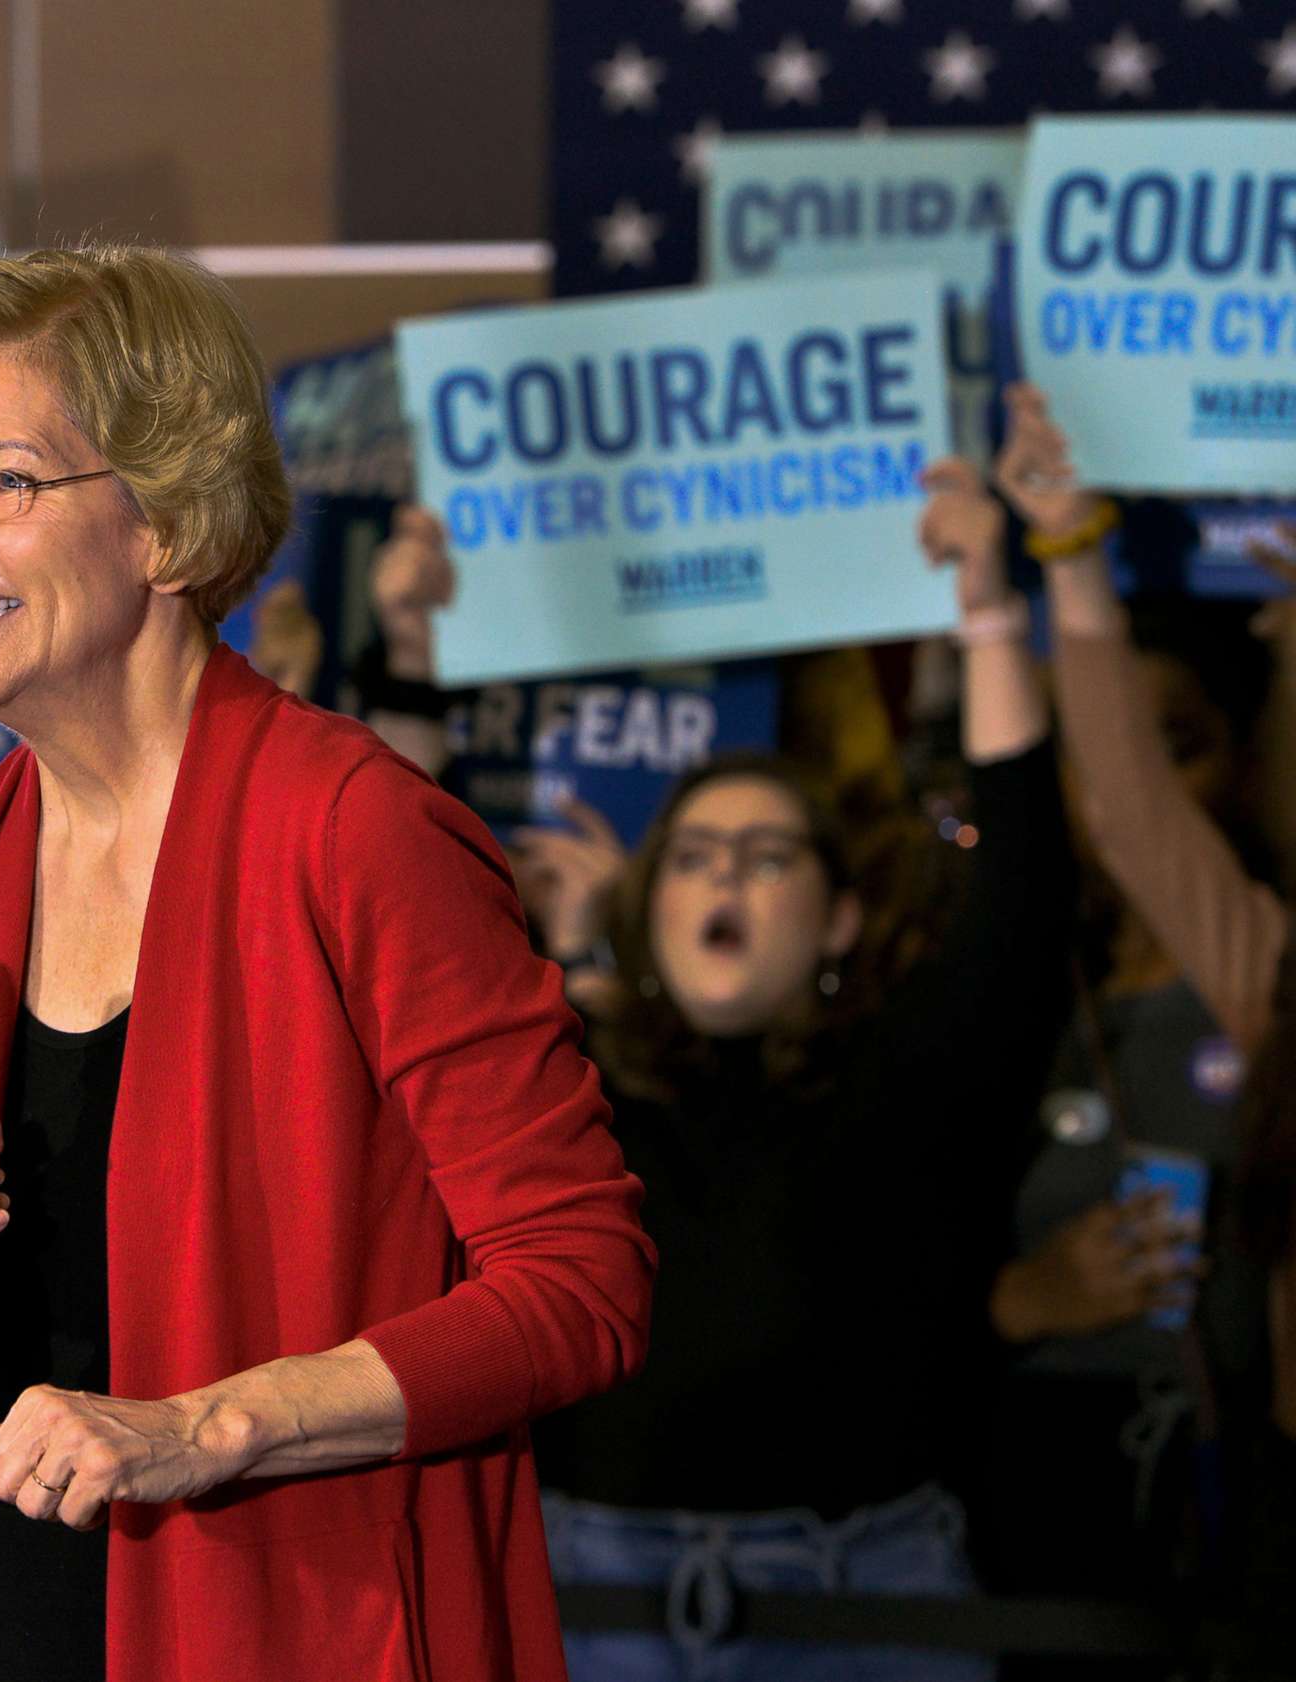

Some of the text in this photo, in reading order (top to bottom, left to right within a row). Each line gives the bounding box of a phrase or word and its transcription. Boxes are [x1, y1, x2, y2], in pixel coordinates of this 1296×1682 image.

[1041, 290, 1197, 357] OVER
[433, 324, 920, 472] COURAGE
[446, 440, 926, 550] OVER CYNICISM
[532, 685, 719, 774] FEAR
